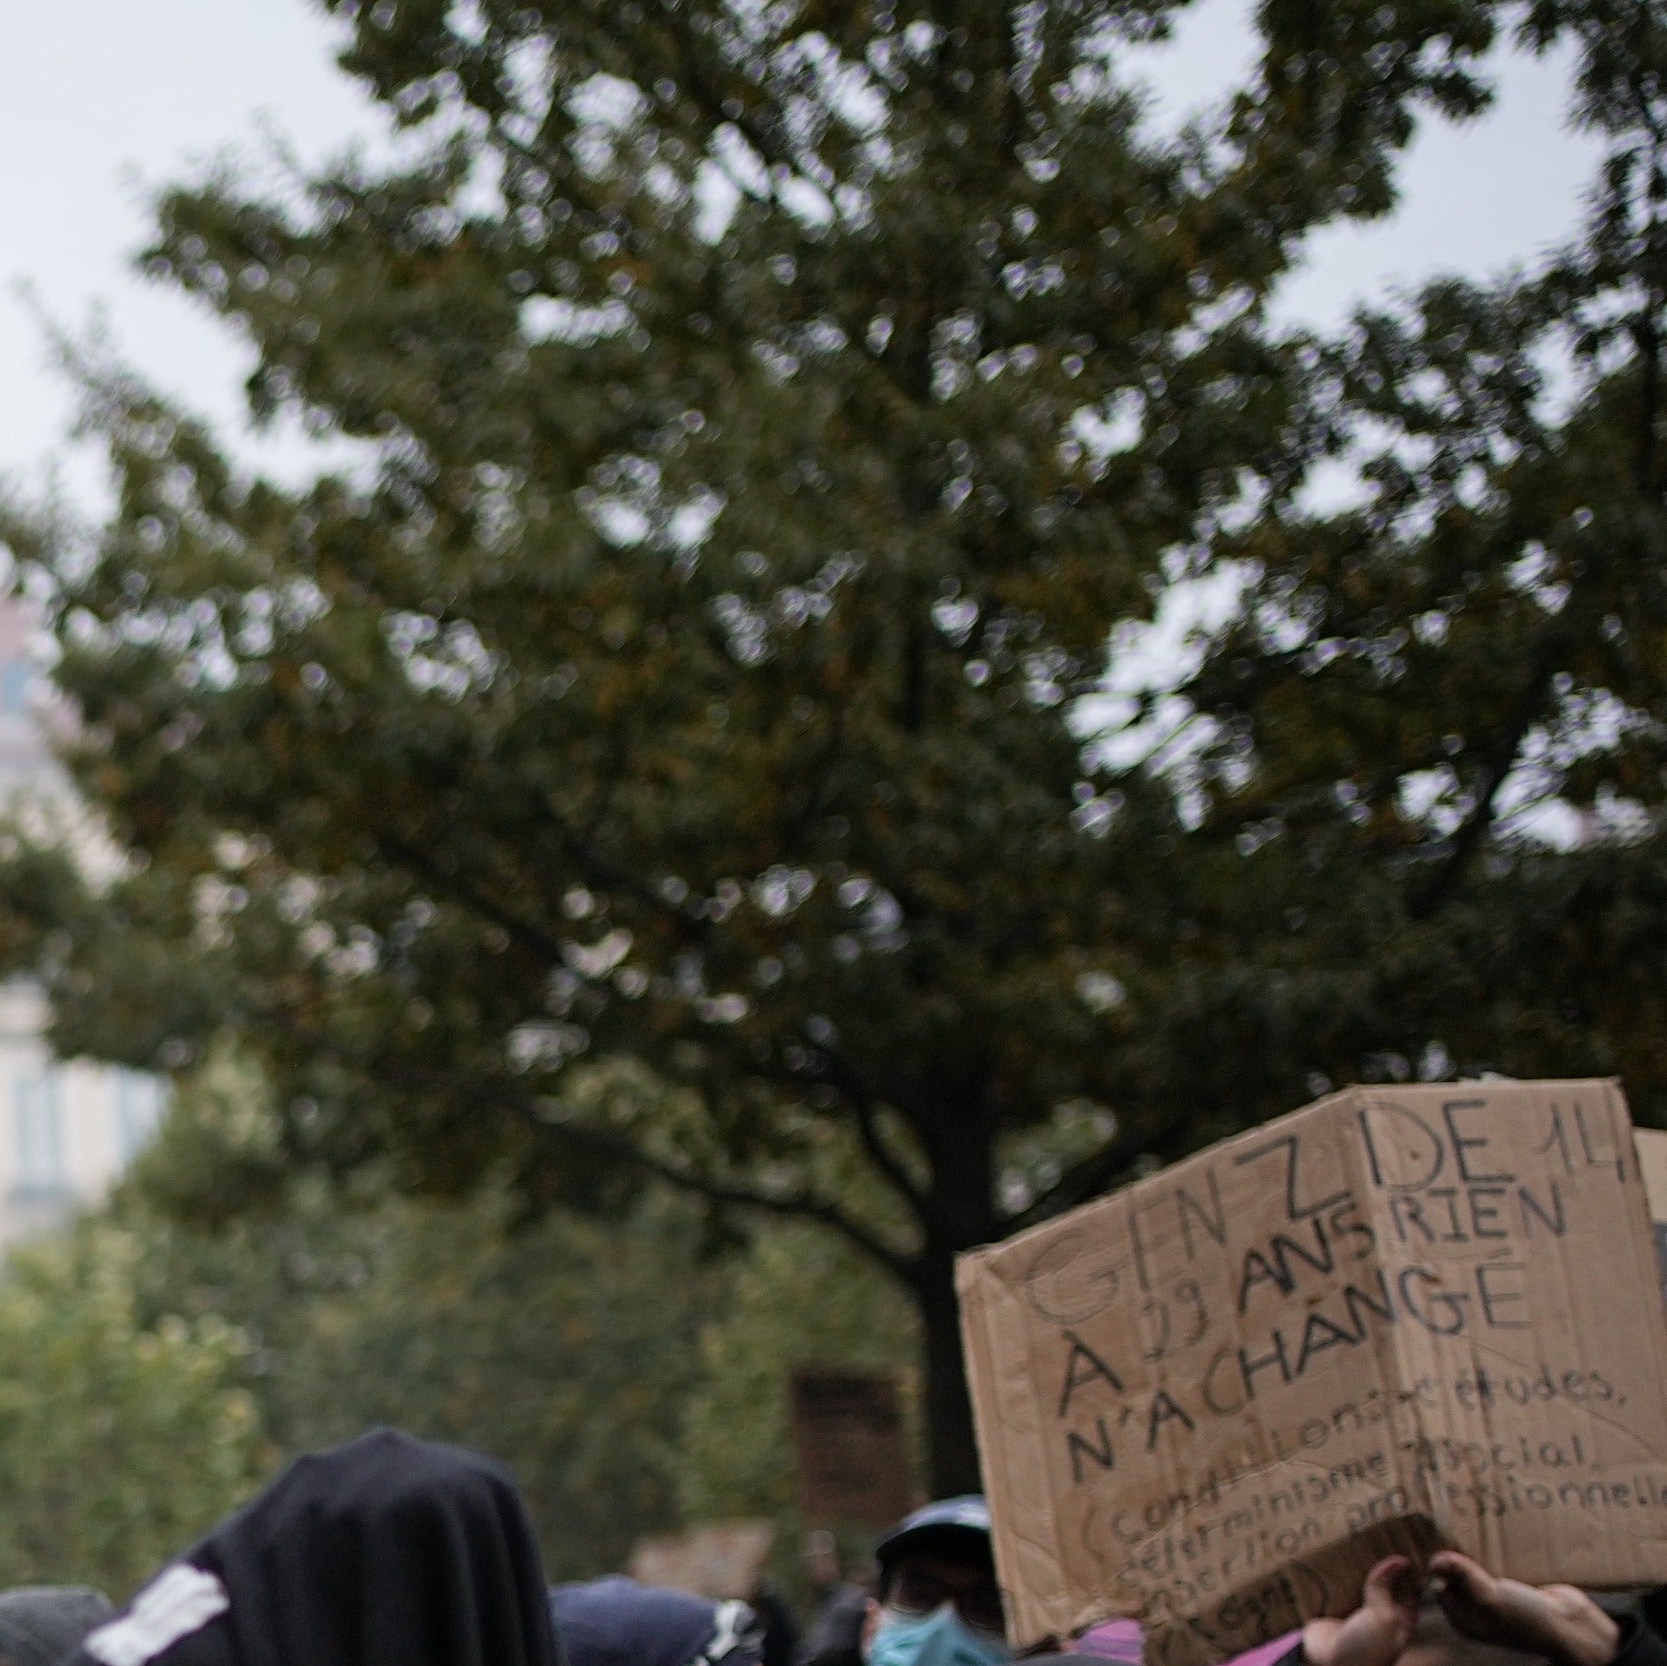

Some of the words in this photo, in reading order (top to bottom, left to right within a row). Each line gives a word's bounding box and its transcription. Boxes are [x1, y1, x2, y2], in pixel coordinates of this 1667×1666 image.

[1025, 1166, 1227, 1324] GEN
[1233, 1132, 1354, 1221] Z
[1357, 1098, 1517, 1192] DE
[1237, 1199, 1378, 1317] ANS
[1388, 1179, 1566, 1243] RIEN
[1066, 1388, 1196, 1484] N'A
